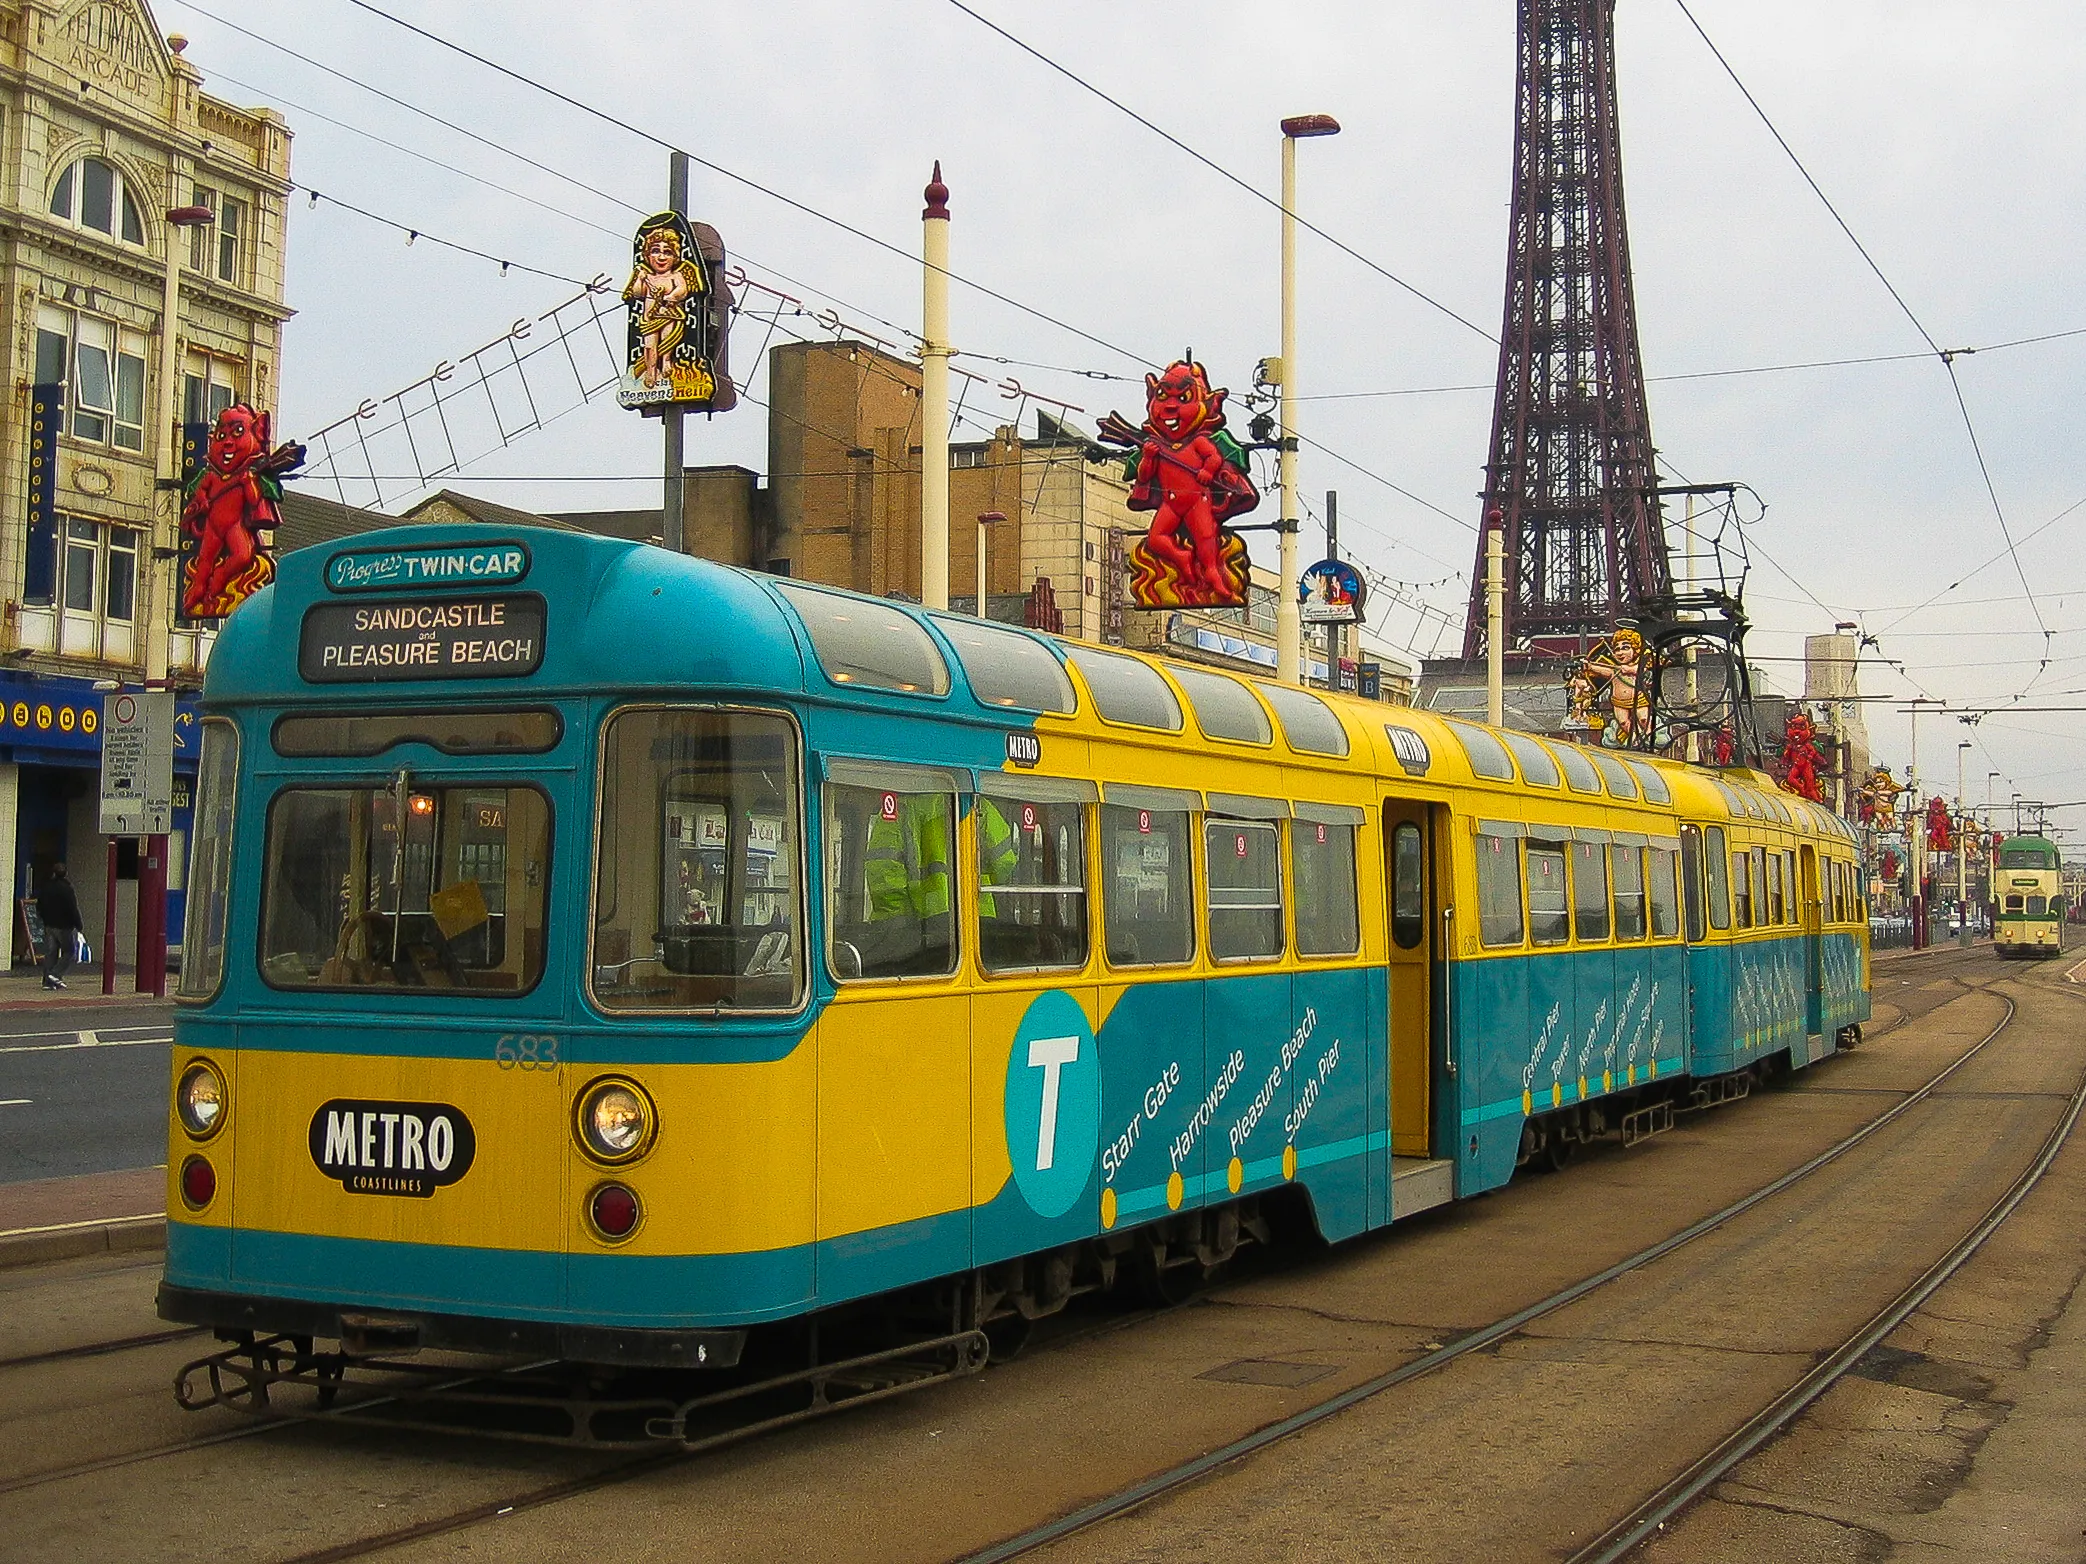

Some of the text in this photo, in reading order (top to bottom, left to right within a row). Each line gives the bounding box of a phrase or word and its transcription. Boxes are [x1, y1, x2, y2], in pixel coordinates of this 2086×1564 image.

[68, 45, 150, 97] ARCADE
[337, 555, 402, 585] Progress
[355, 603, 505, 631] SANDCASTLE
[418, 631, 435, 640] and
[323, 639, 532, 667] PLEASURE BEACH
[1009, 735, 1038, 760] METRO
[1386, 728, 1427, 763] METRO
[495, 1035, 559, 1071] 683
[1523, 1001, 1560, 1088] Central Pier
[1028, 1036, 1080, 1171] T
[1229, 1007, 1318, 1156] Pleasure Beach
[1285, 1039, 1341, 1143] South Pier
[1102, 1062, 1180, 1183] Starr Gate
[1169, 1049, 1245, 1171] Harrowside
[323, 1111, 454, 1171] METRO
[353, 1176, 422, 1192] COASTLINES
